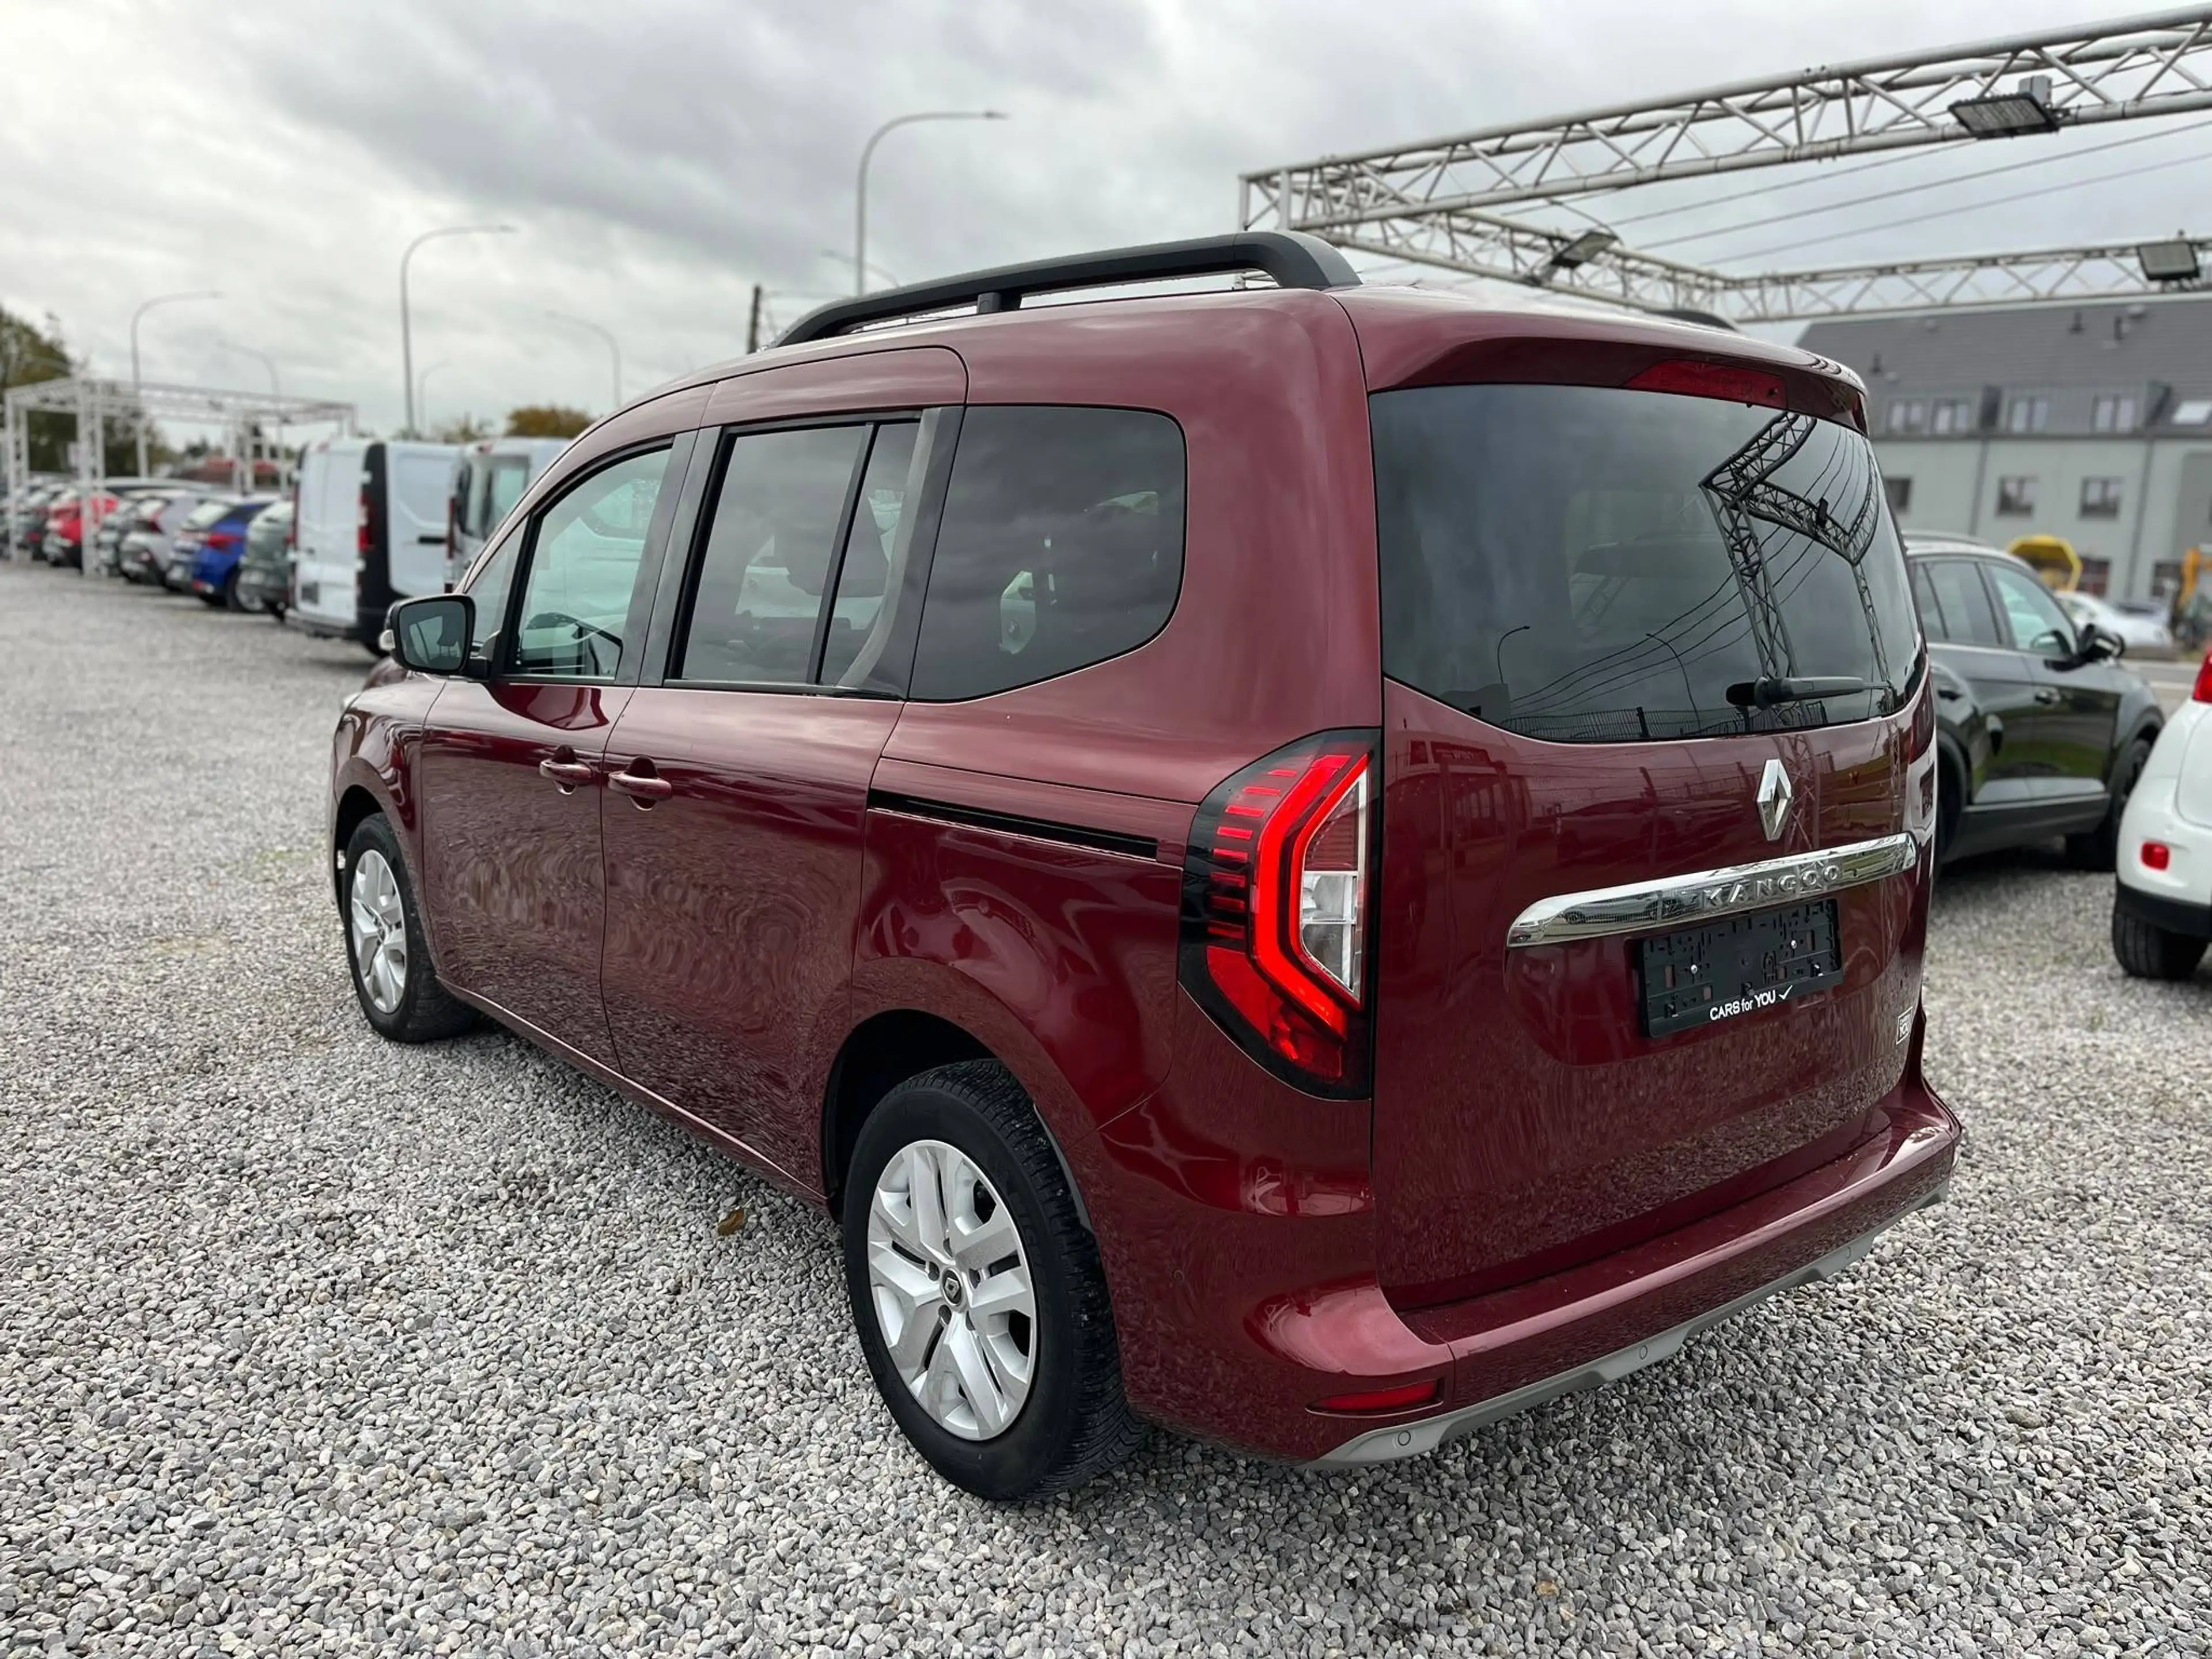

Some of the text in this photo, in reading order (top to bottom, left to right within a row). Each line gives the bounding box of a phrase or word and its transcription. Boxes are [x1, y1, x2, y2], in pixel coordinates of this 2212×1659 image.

[1702, 865, 1840, 908] KANGOO
[1710, 990, 1776, 1020] CARS for YOU
